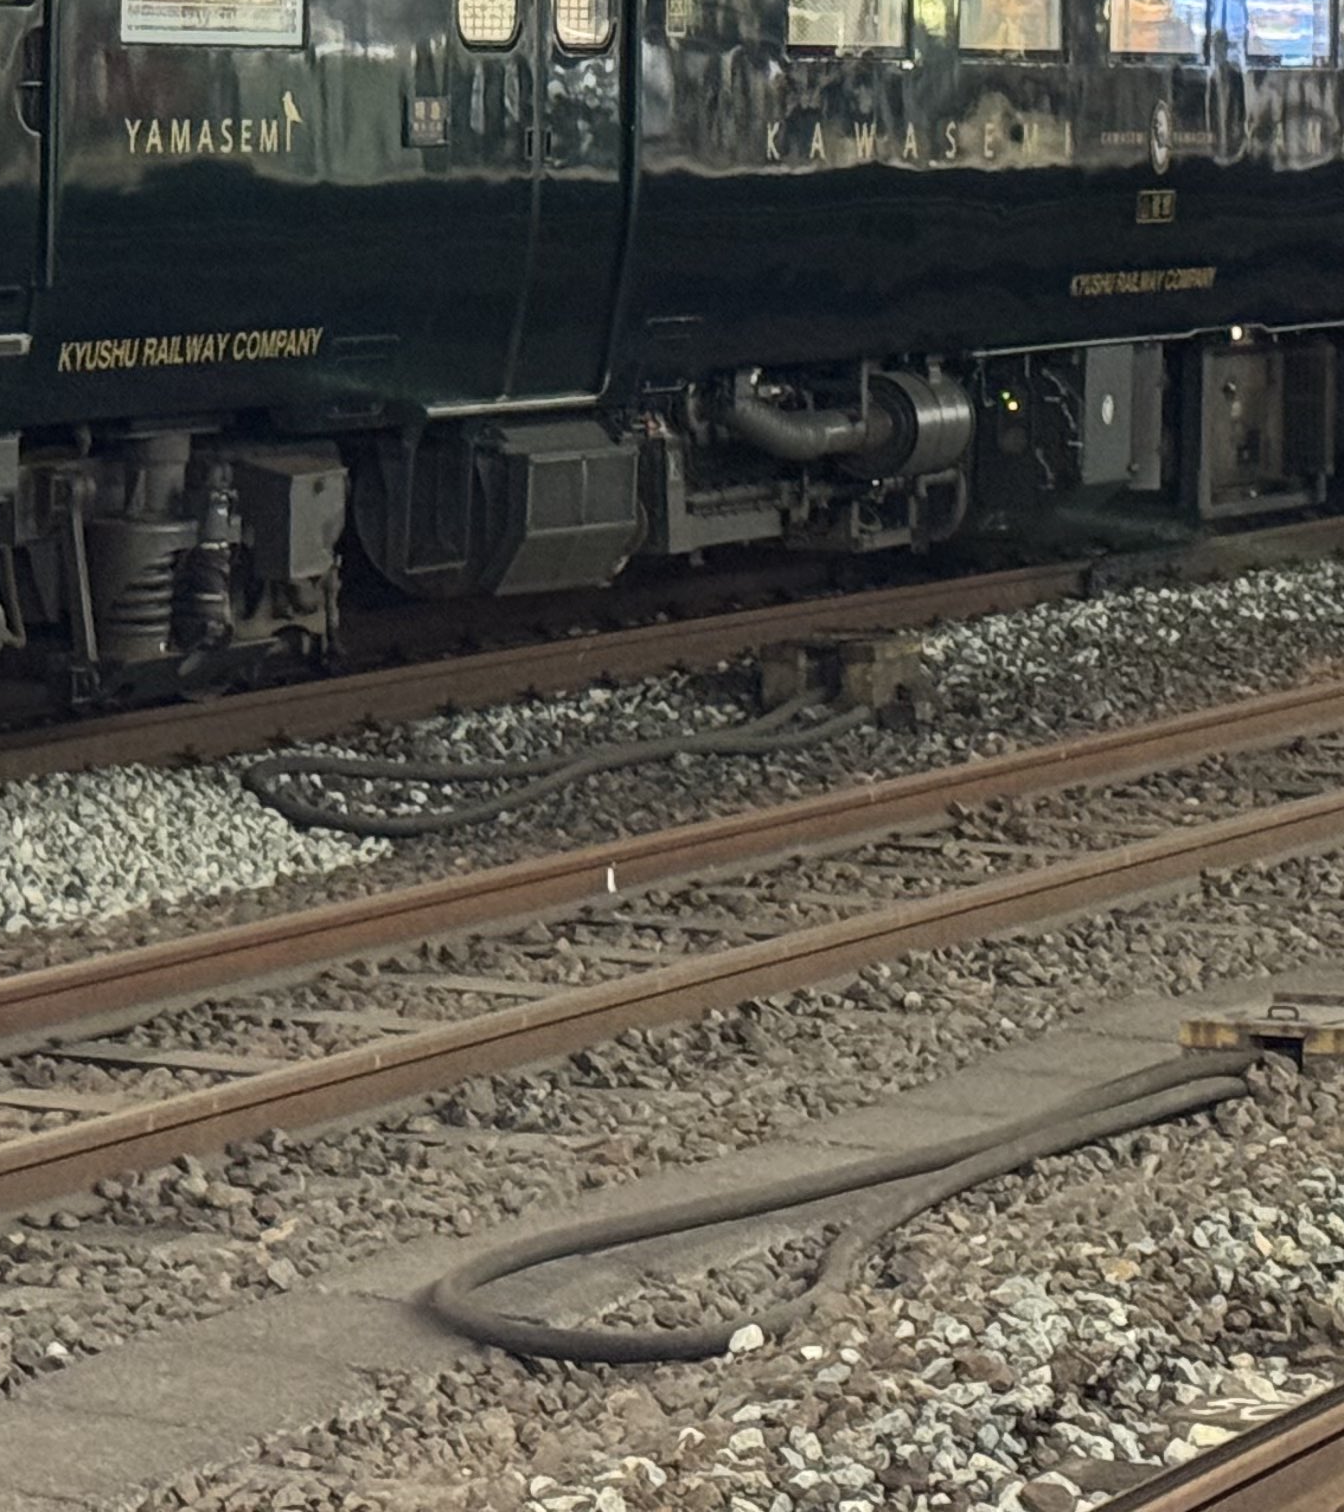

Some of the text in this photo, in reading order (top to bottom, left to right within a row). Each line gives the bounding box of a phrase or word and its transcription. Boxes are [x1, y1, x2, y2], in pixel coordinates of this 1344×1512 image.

[124, 104, 297, 154] YAMASEMI
[766, 120, 1073, 161] KAWASEMI
[58, 327, 324, 372] KYUSHU RAILWAY COMPANY
